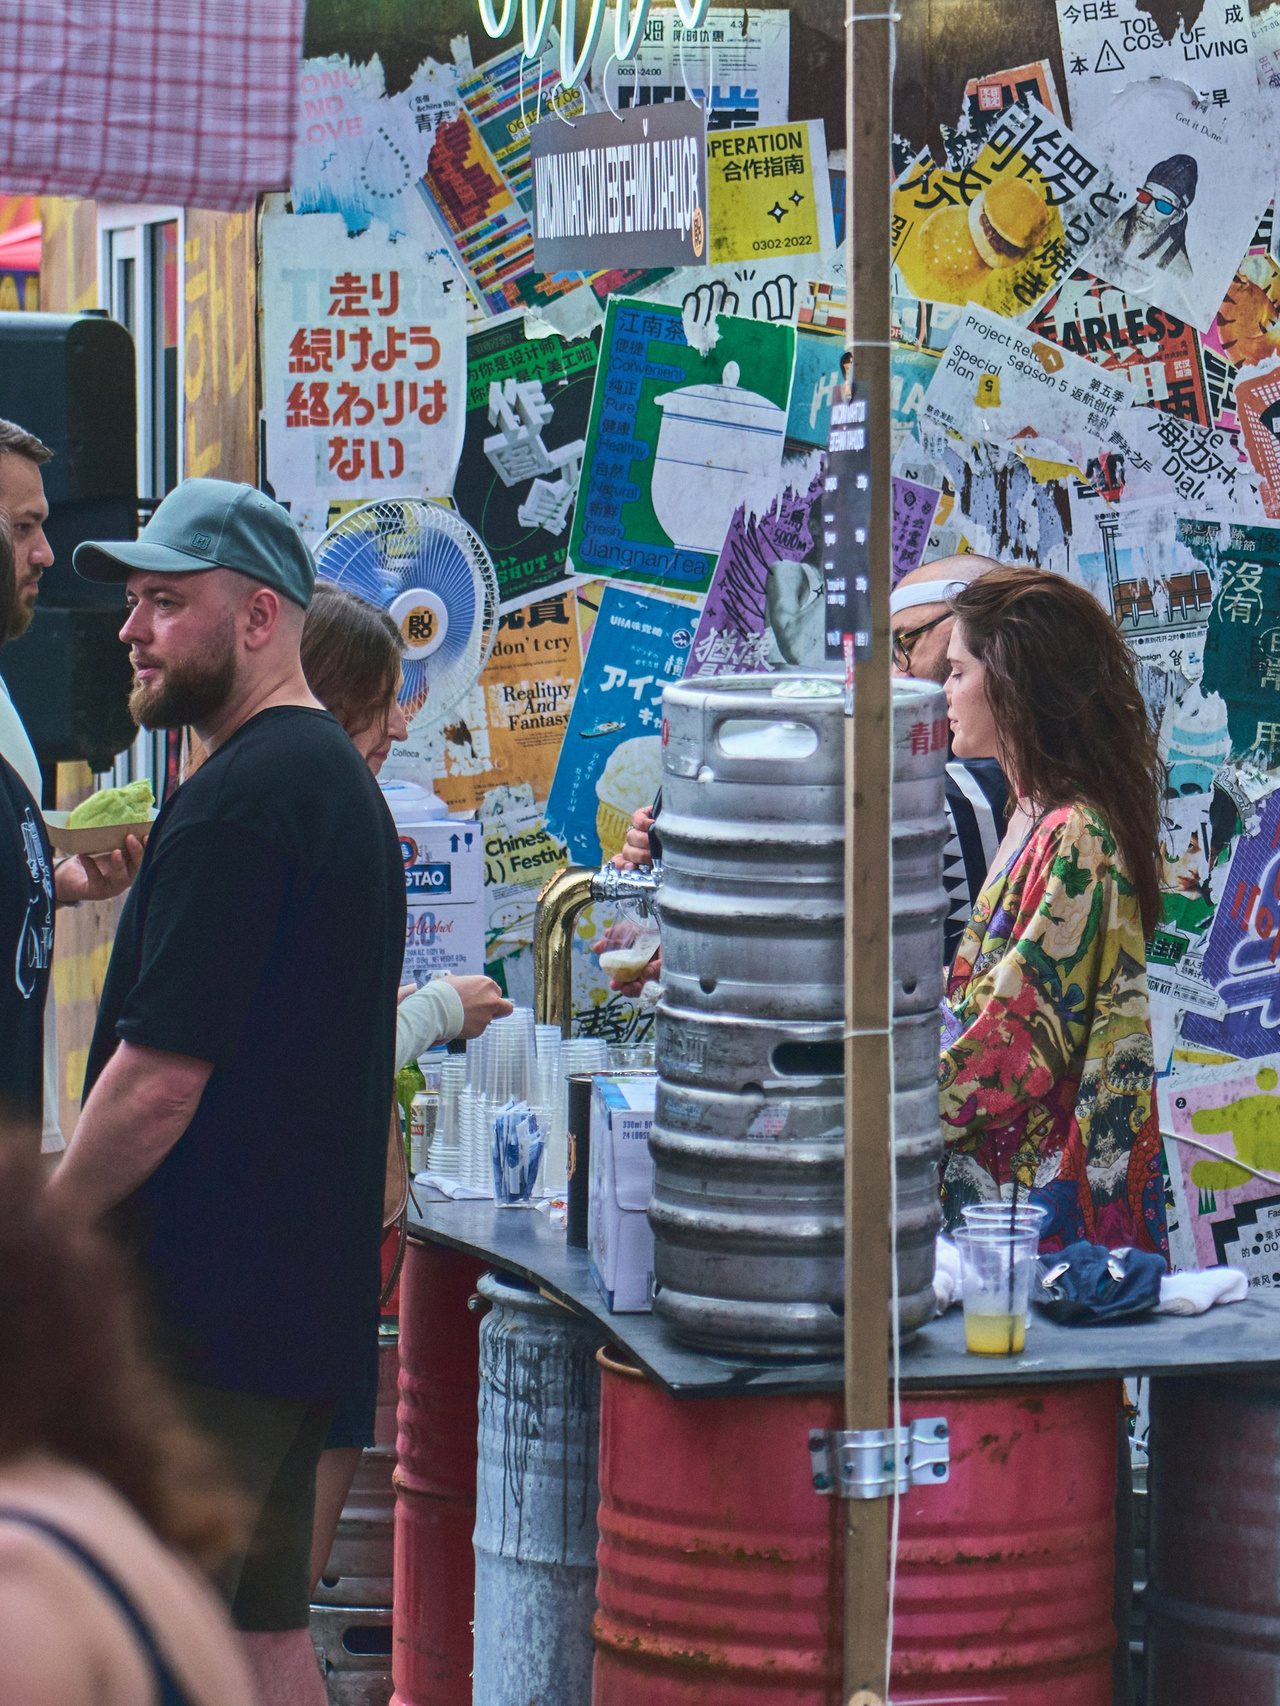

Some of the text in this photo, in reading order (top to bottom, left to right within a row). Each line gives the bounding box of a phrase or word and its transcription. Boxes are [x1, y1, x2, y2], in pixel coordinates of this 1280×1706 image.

[1063, 1, 1119, 25] 今日生
[1183, 38, 1248, 62] LIVING
[1070, 56, 1089, 76] 本
[722, 154, 805, 183] 合作指南
[535, 156, 564, 239] МАКСИМ
[564, 147, 597, 238] МАНГОЛ
[327, 271, 399, 317] 走り
[618, 311, 685, 341] 江南茶
[966, 315, 1012, 347] Project
[289, 326, 441, 374] 続けよう
[953, 344, 1003, 377] Special
[611, 358, 685, 382] Convenient
[946, 358, 975, 383] Plan
[1006, 354, 1069, 394] Season 5
[286, 379, 447, 428] 終わりは
[1090, 377, 1126, 405] 第五季
[605, 398, 635, 414] Pure
[328, 436, 404, 481] ない
[598, 438, 646, 460] Healthy
[592, 480, 638, 498] Natural
[585, 522, 622, 538] Fresh
[543, 636, 573, 654] cry
[524, 698, 558, 714] And
[1241, 1248, 1251, 1258] 的
